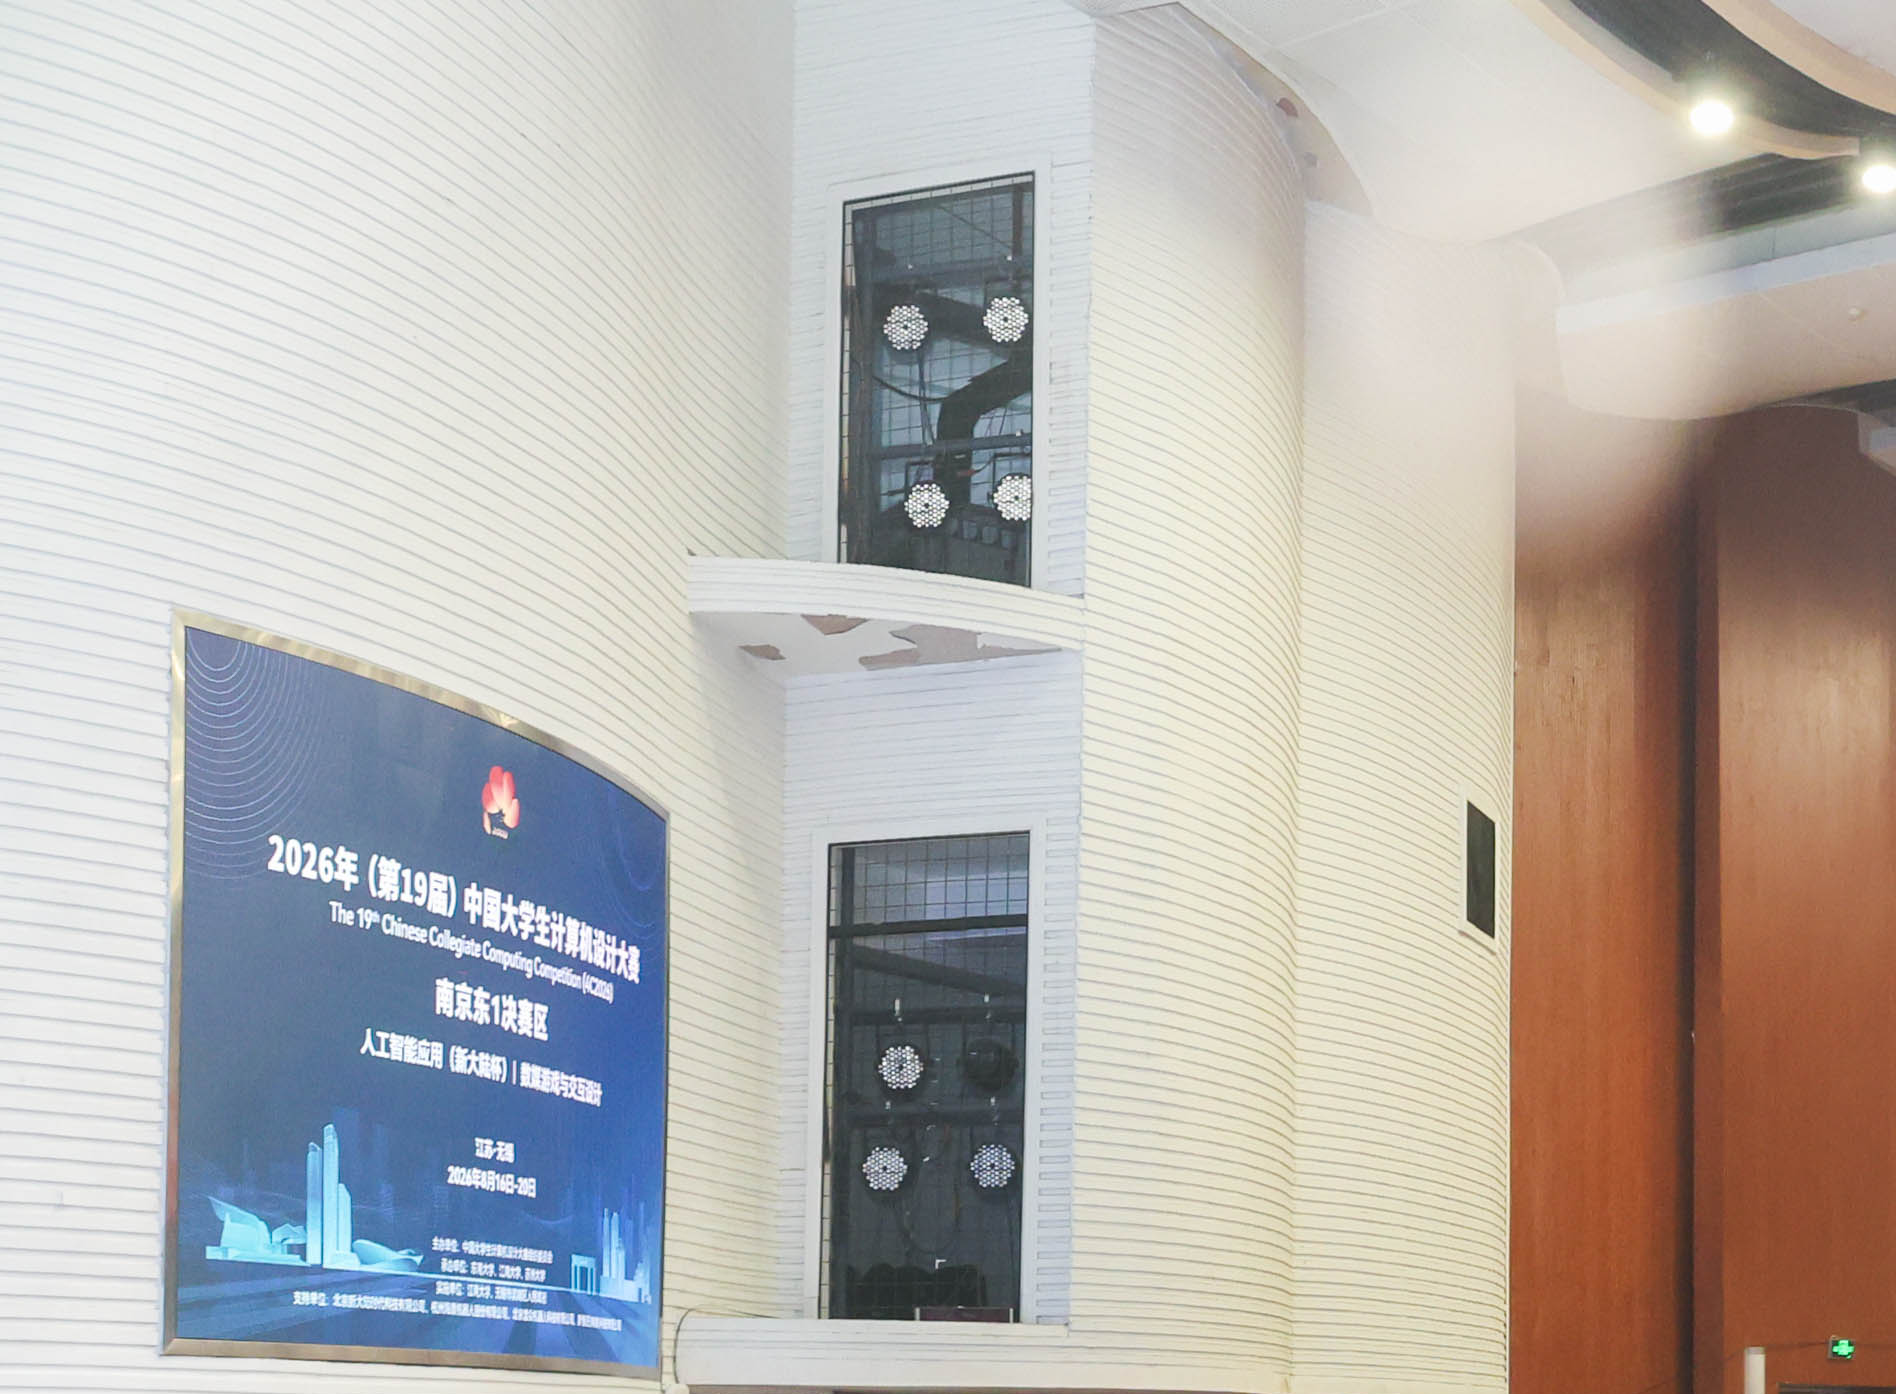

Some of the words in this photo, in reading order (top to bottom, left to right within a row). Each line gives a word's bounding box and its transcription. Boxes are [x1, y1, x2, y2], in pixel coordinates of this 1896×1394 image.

[329, 900, 355, 927] The
[381, 912, 427, 944] Chinese
[428, 925, 482, 959] Collegiate
[482, 941, 534, 979] Computing
[534, 956, 582, 991] Competition
[435, 976, 549, 1042] 南京东1决赛区
